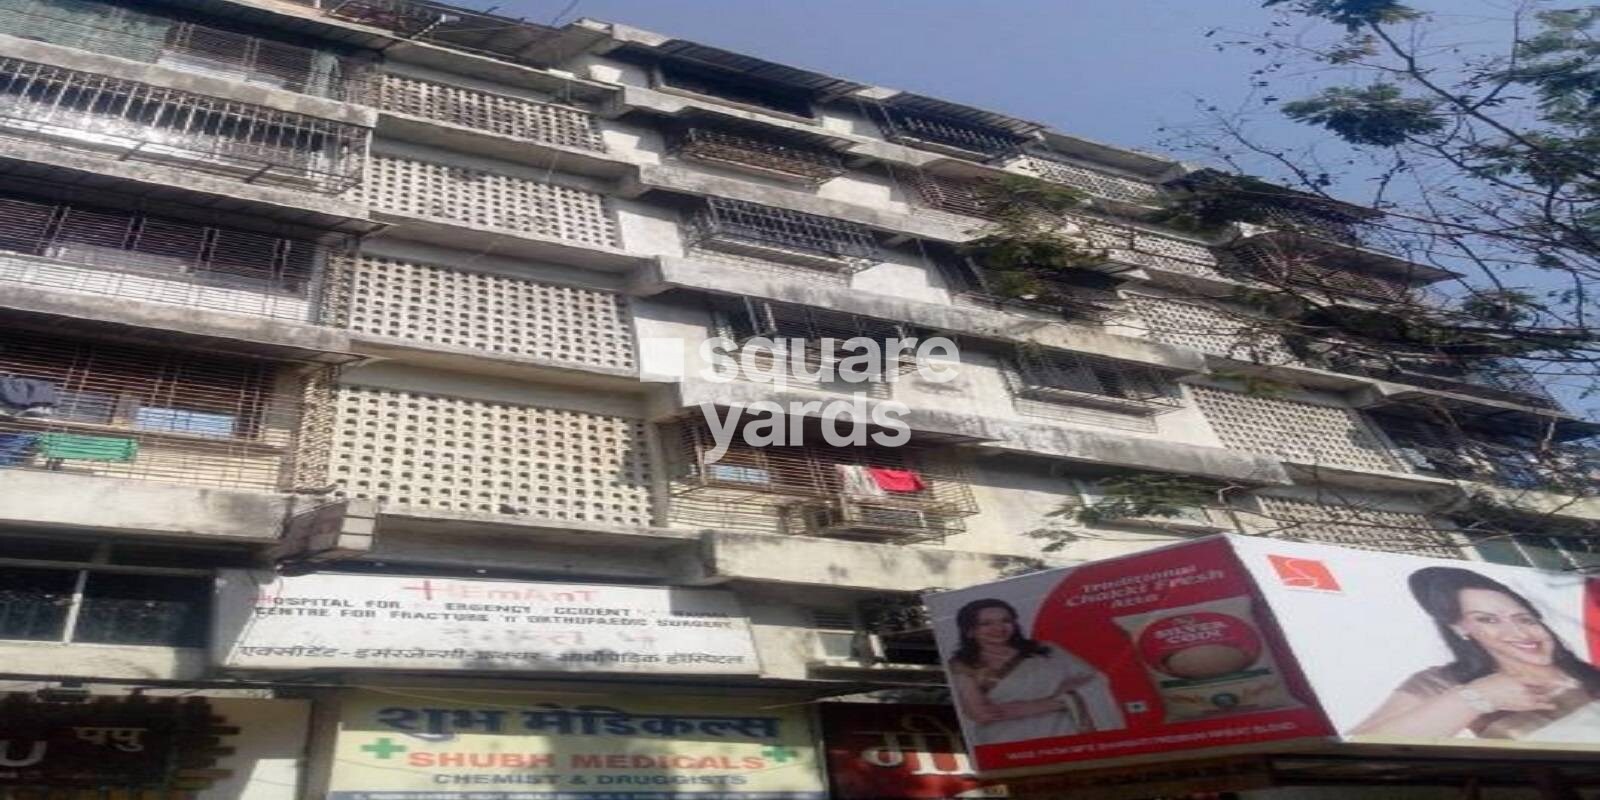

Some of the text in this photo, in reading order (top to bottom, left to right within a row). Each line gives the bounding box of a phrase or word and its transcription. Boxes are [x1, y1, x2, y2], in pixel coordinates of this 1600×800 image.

[365, 600, 400, 609] FOR
[255, 607, 330, 617] CENTRE
[340, 609, 376, 618] FOR
[390, 611, 488, 622] FRACTURE
[408, 752, 765, 770] SHUBH MEDICALS
[433, 774, 748, 785] CHEMIST & DRUGGISTS
